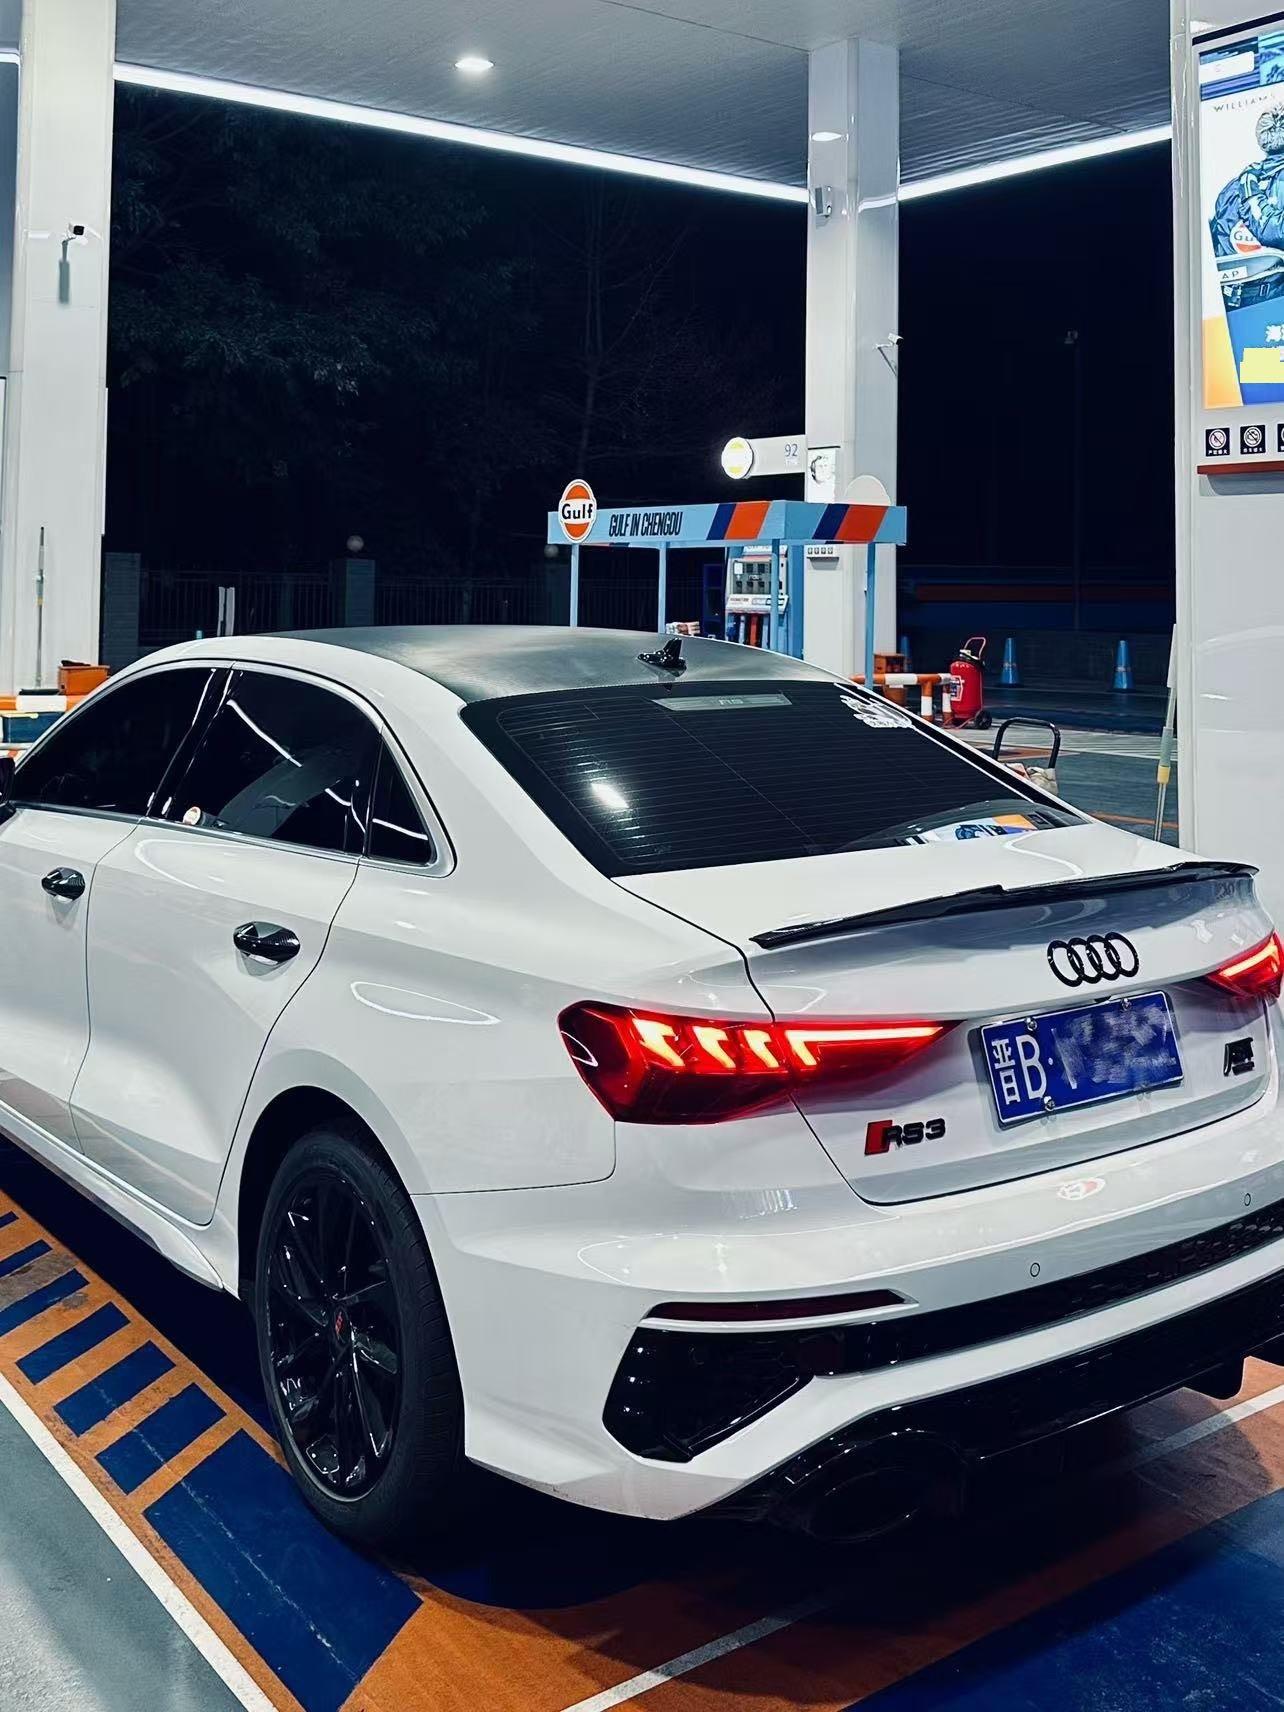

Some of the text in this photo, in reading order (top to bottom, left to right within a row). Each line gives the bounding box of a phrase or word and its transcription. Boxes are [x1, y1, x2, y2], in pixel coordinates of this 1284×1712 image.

[784, 443, 798, 457] 92
[561, 503, 593, 520] Gulf
[608, 511, 683, 537] GULF IN CHENGDU
[883, 1117, 946, 1149] RS3
